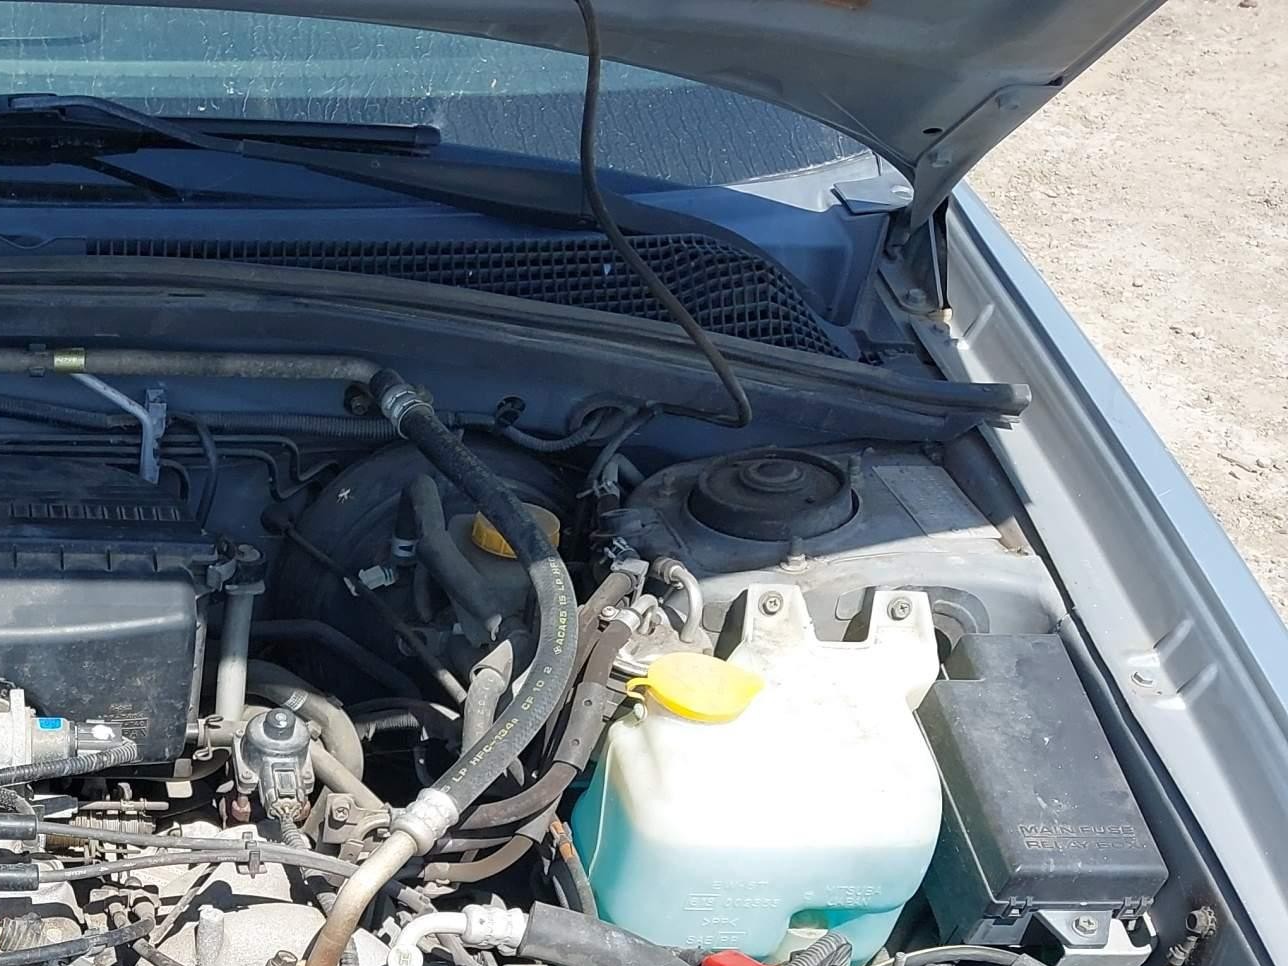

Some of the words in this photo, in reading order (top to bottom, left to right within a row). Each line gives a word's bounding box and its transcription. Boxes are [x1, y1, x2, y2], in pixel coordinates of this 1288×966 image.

[452, 767, 468, 782] LP
[521, 695, 535, 711] CF
[1018, 824, 1074, 835] MAIN
[1079, 825, 1135, 835] FUSE
[1025, 840, 1089, 850] RELAY
